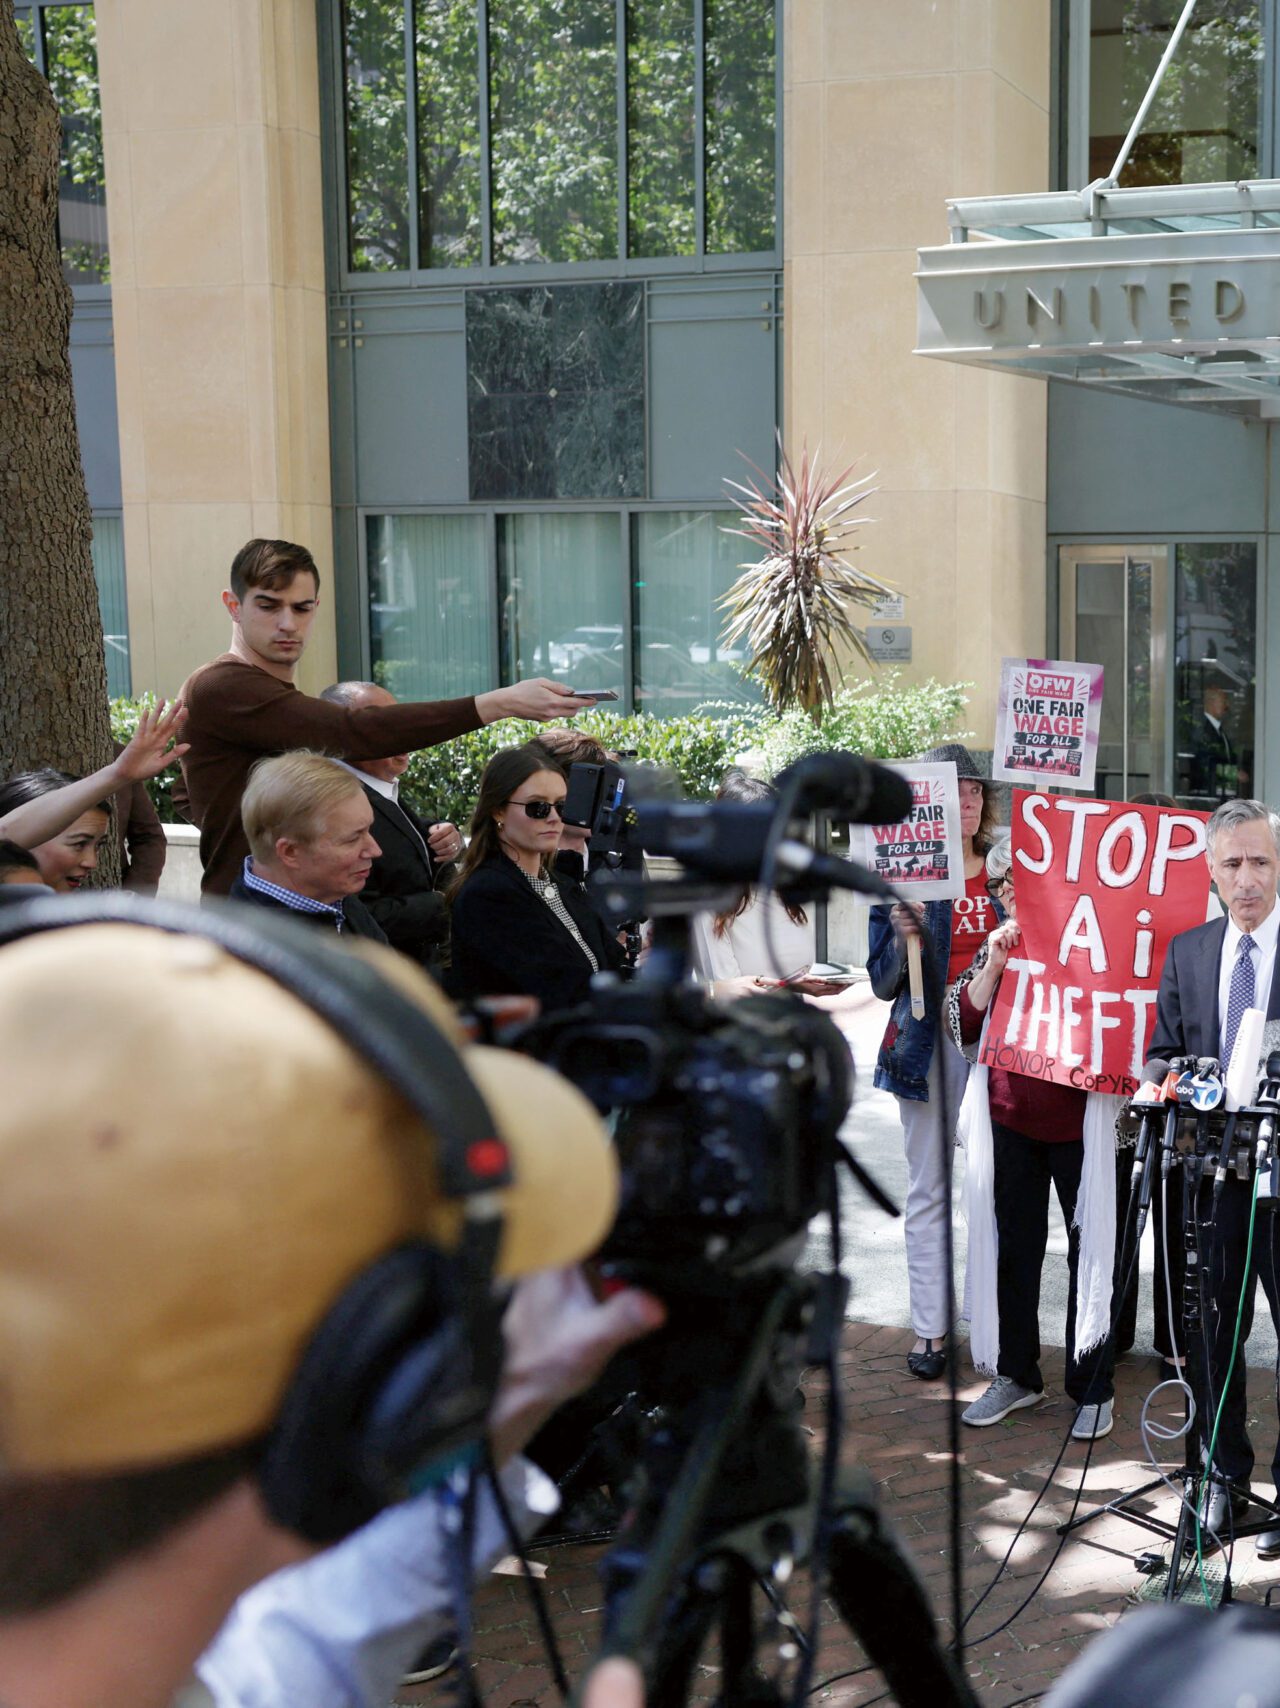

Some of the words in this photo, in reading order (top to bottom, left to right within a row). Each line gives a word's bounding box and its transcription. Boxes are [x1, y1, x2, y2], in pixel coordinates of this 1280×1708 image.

[974, 279, 1245, 329] UNITED
[1028, 674, 1072, 691] OFW
[1013, 698, 1044, 715] ONE
[1050, 701, 1084, 717] FAIR
[1014, 714, 1084, 736] WAGE
[1026, 734, 1047, 745] FOR
[1051, 736, 1072, 746] ALL
[909, 805, 944, 823] FAIR
[872, 821, 946, 844] WAGE
[888, 844, 911, 855] FOR
[915, 842, 936, 852] ALL
[1015, 794, 1207, 896] STOP
[951, 896, 991, 914] OP
[954, 914, 987, 934] AI
[1003, 957, 1158, 1081] THEFT
[981, 1038, 1056, 1082] HONOR
[1069, 1066, 1140, 1095] COPYR
[1176, 1085, 1195, 1095] abc
